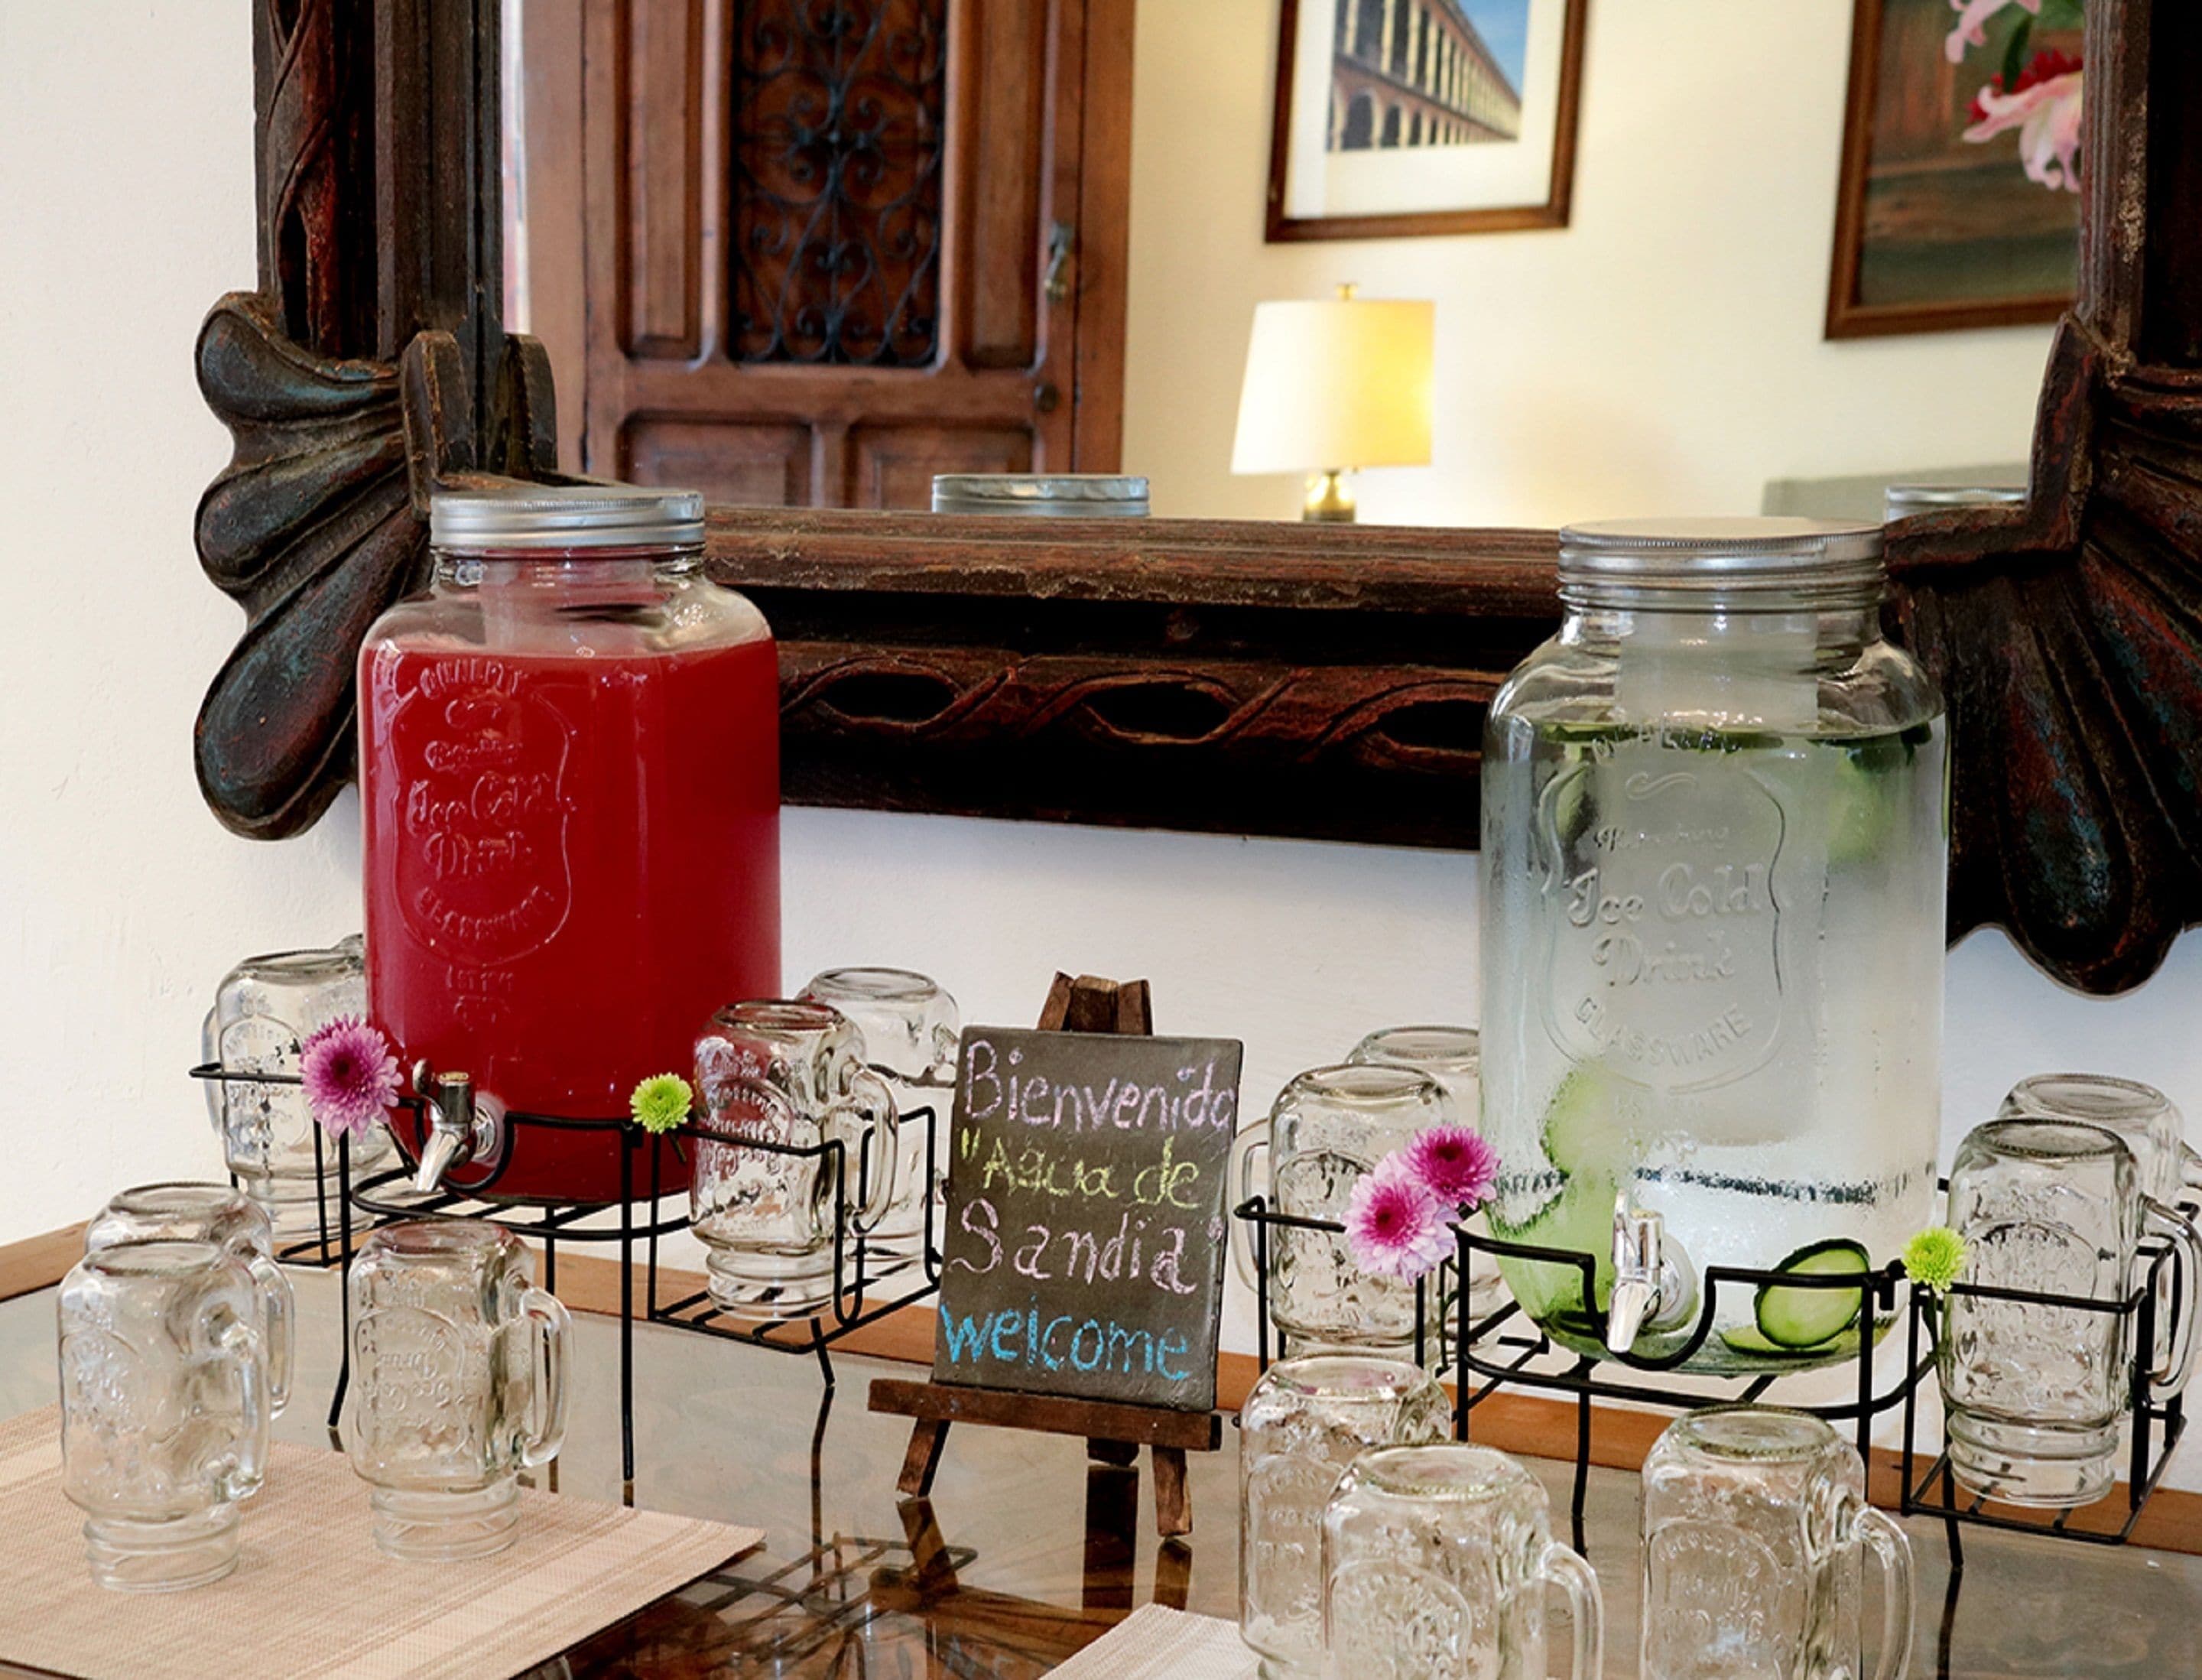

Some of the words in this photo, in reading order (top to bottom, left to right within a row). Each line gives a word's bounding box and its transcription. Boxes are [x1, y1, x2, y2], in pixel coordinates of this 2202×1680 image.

[1564, 867, 1644, 928] Ice
[1658, 863, 1763, 922] Cold
[1132, 1136, 1203, 1209] de
